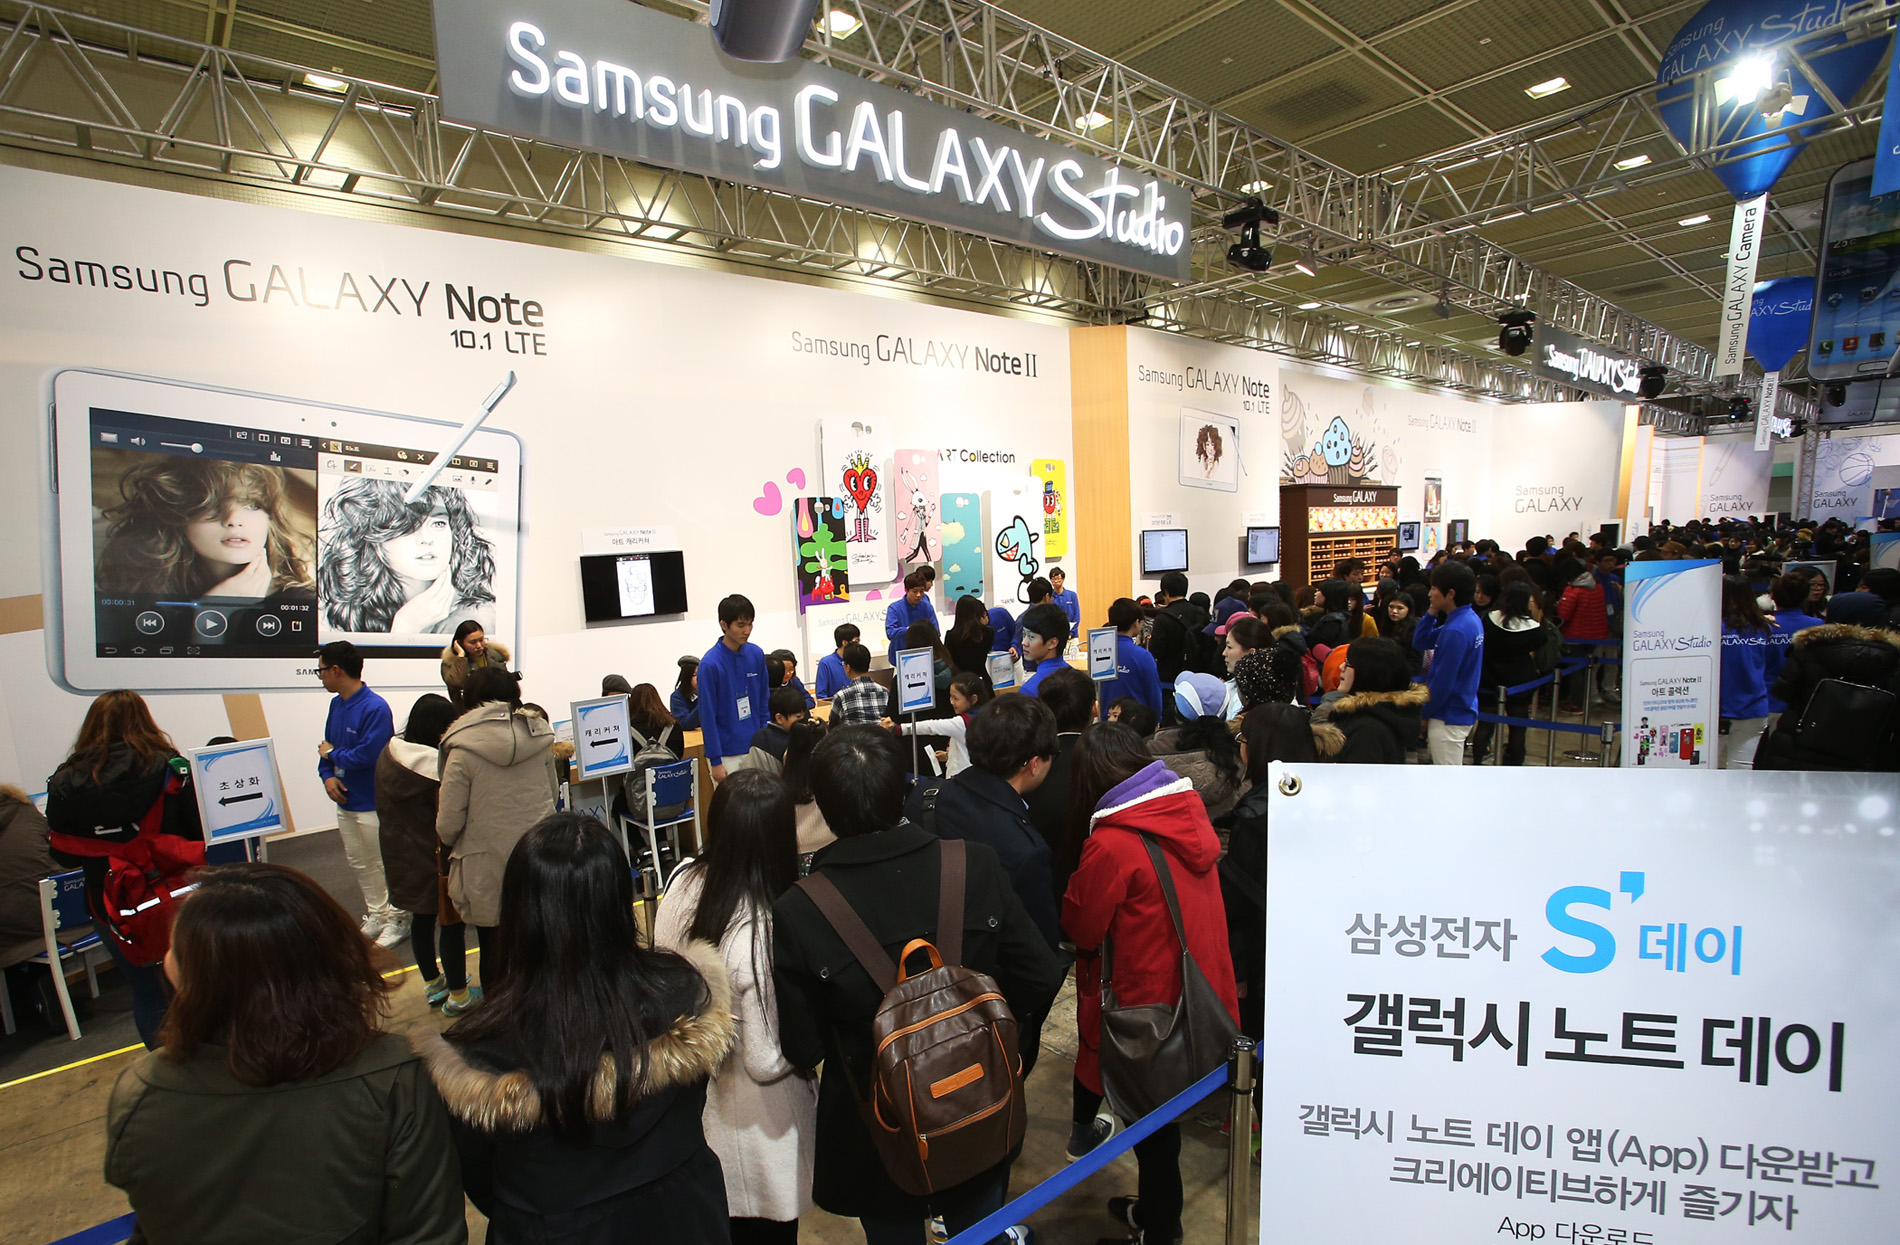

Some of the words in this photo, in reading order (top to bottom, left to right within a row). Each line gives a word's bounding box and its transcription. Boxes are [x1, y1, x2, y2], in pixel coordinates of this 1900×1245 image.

[507, 21, 781, 169] Samsung
[795, 84, 1045, 218] GALAXY
[1034, 158, 1184, 256] Studio
[1735, 207, 1757, 261] Camera
[15, 246, 210, 307] Samsung
[224, 259, 431, 317] GALAXY
[445, 283, 545, 329] Note
[1727, 264, 1748, 321] GALAXY
[450, 329, 493, 351] 10.1
[505, 332, 548, 356] LTE
[1724, 322, 1744, 366] Samsung
[791, 330, 871, 366] Samsung
[876, 334, 969, 370] GALAXY
[975, 346, 1022, 376] Note
[1544, 343, 1580, 382] Samsung
[1576, 347, 1617, 386] GALAXY
[1138, 363, 1184, 392] Samsung
[1185, 366, 1240, 398] GALAXY
[1241, 375, 1271, 399] Note
[1256, 400, 1271, 415] LTE
[1760, 399, 1772, 426] GALAXY
[1430, 413, 1457, 433] GALAXY
[959, 448, 1016, 464] Collection
[1333, 493, 1353, 506] Samsung
[1352, 490, 1377, 504] GALAXY
[1514, 485, 1564, 498] Samsung
[1709, 493, 1743, 503] Samsung
[1814, 490, 1847, 499] Samsung
[1513, 496, 1584, 513] GALAXY
[1708, 501, 1754, 513] GALAXY
[1813, 497, 1858, 509] GALAXY
[101, 599, 136, 607] 00:00:31
[280, 604, 310, 612] 00:01:32
[1633, 630, 1665, 639] Samsung
[1633, 639, 1676, 652] GALAXY
[1675, 635, 1712, 651] Studio
[1657, 677, 1682, 686] GALAXY
[1682, 676, 1697, 684] Note
[1651, 688, 1666, 697] 아트
[63, 881, 85, 892] GALA
[1343, 912, 1518, 963] 삼성전자
[1638, 922, 1744, 976] 데이
[1342, 992, 1531, 1068] 갤럭시
[1544, 1007, 1686, 1071] 노트
[1701, 1015, 1846, 1093] 데이
[1298, 1103, 1395, 1145] 갤럭시
[1406, 1111, 1476, 1148] 노트
[1486, 1119, 1555, 1160] 데이
[1565, 1126, 1711, 1178] 앱(App)
[1718, 1142, 1881, 1191] 다운받고
[1389, 1155, 1668, 1216] 크리에이티브하게
[1679, 1182, 1800, 1232] 즐기자
[1497, 1216, 1546, 1242] App
